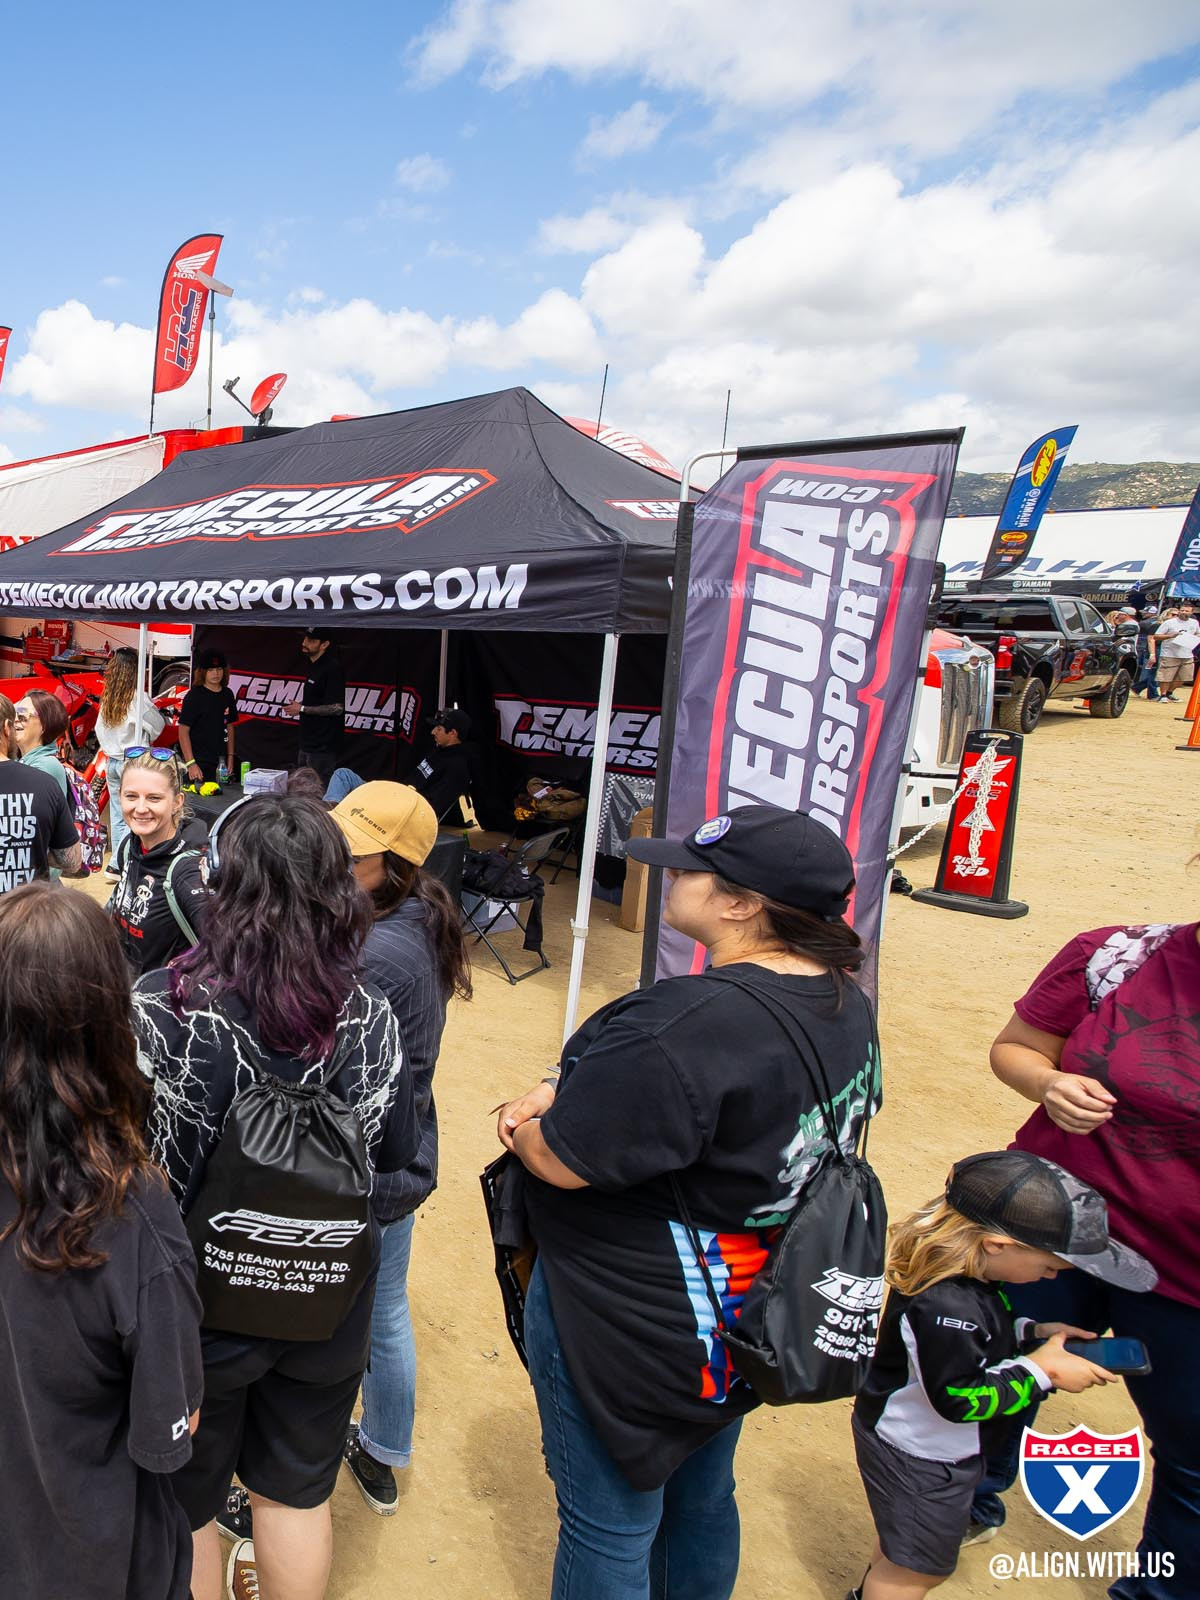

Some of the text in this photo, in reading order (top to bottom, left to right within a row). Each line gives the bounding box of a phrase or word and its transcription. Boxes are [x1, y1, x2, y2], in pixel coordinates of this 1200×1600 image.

[60, 474, 464, 552] TEMECULA
[98, 507, 413, 552] MOTORSPORTS
[1022, 580, 1052, 588] YAMAHA
[1081, 593, 1129, 602] YAMALUBE
[953, 864, 990, 878] RED
[203, 1242, 351, 1272] 5755 KEARNY VILLA RD.
[203, 1256, 345, 1283] SAN DIEGO, CA 92123
[229, 1276, 315, 1293] 858-278-6635
